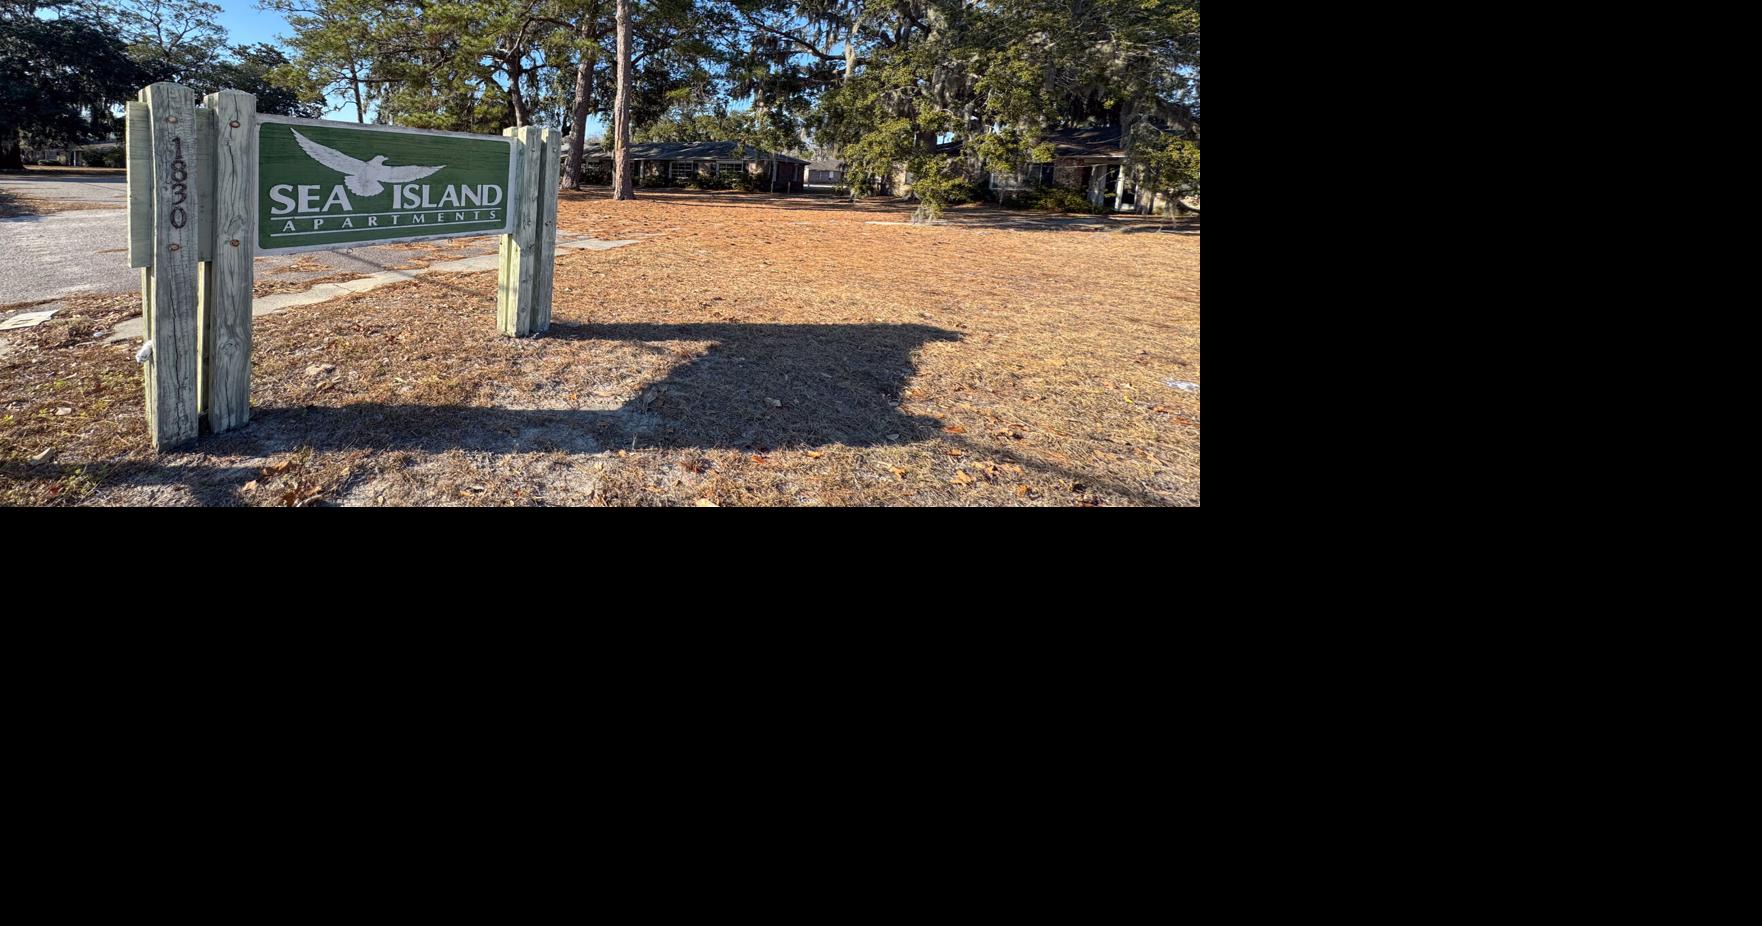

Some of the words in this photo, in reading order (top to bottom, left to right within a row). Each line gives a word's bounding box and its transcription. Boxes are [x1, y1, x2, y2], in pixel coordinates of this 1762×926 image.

[169, 136, 188, 229] 1830
[270, 184, 353, 214] SEA
[392, 184, 503, 209] ISLAND
[283, 210, 496, 231] APARTMENTS
